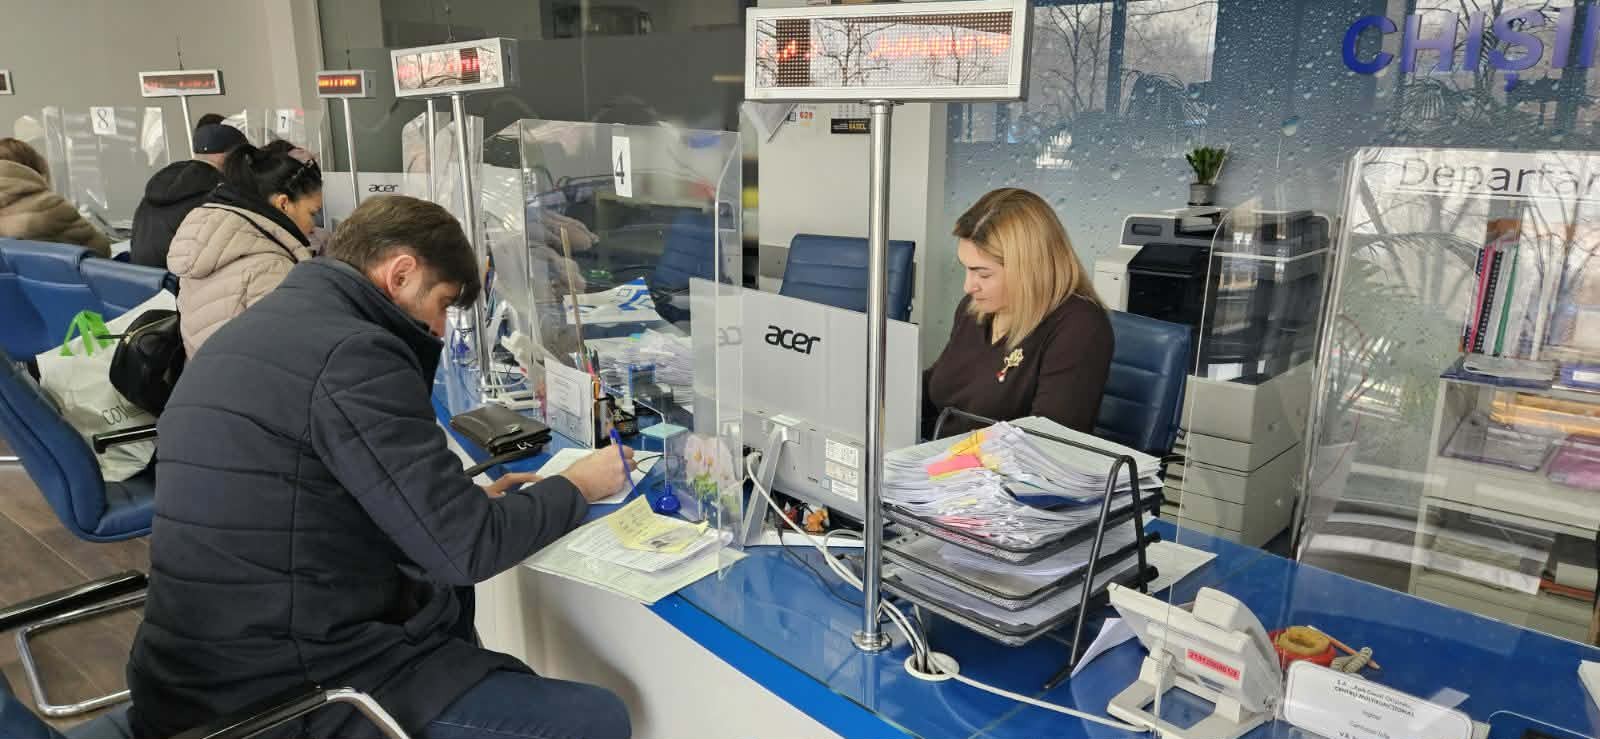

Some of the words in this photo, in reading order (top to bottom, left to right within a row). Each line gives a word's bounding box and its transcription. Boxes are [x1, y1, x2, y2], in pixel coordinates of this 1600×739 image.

[97, 108, 109, 129] 8
[280, 116, 287, 128] 7
[611, 151, 624, 184] 4
[368, 184, 399, 192] acer
[764, 324, 821, 354] acer
